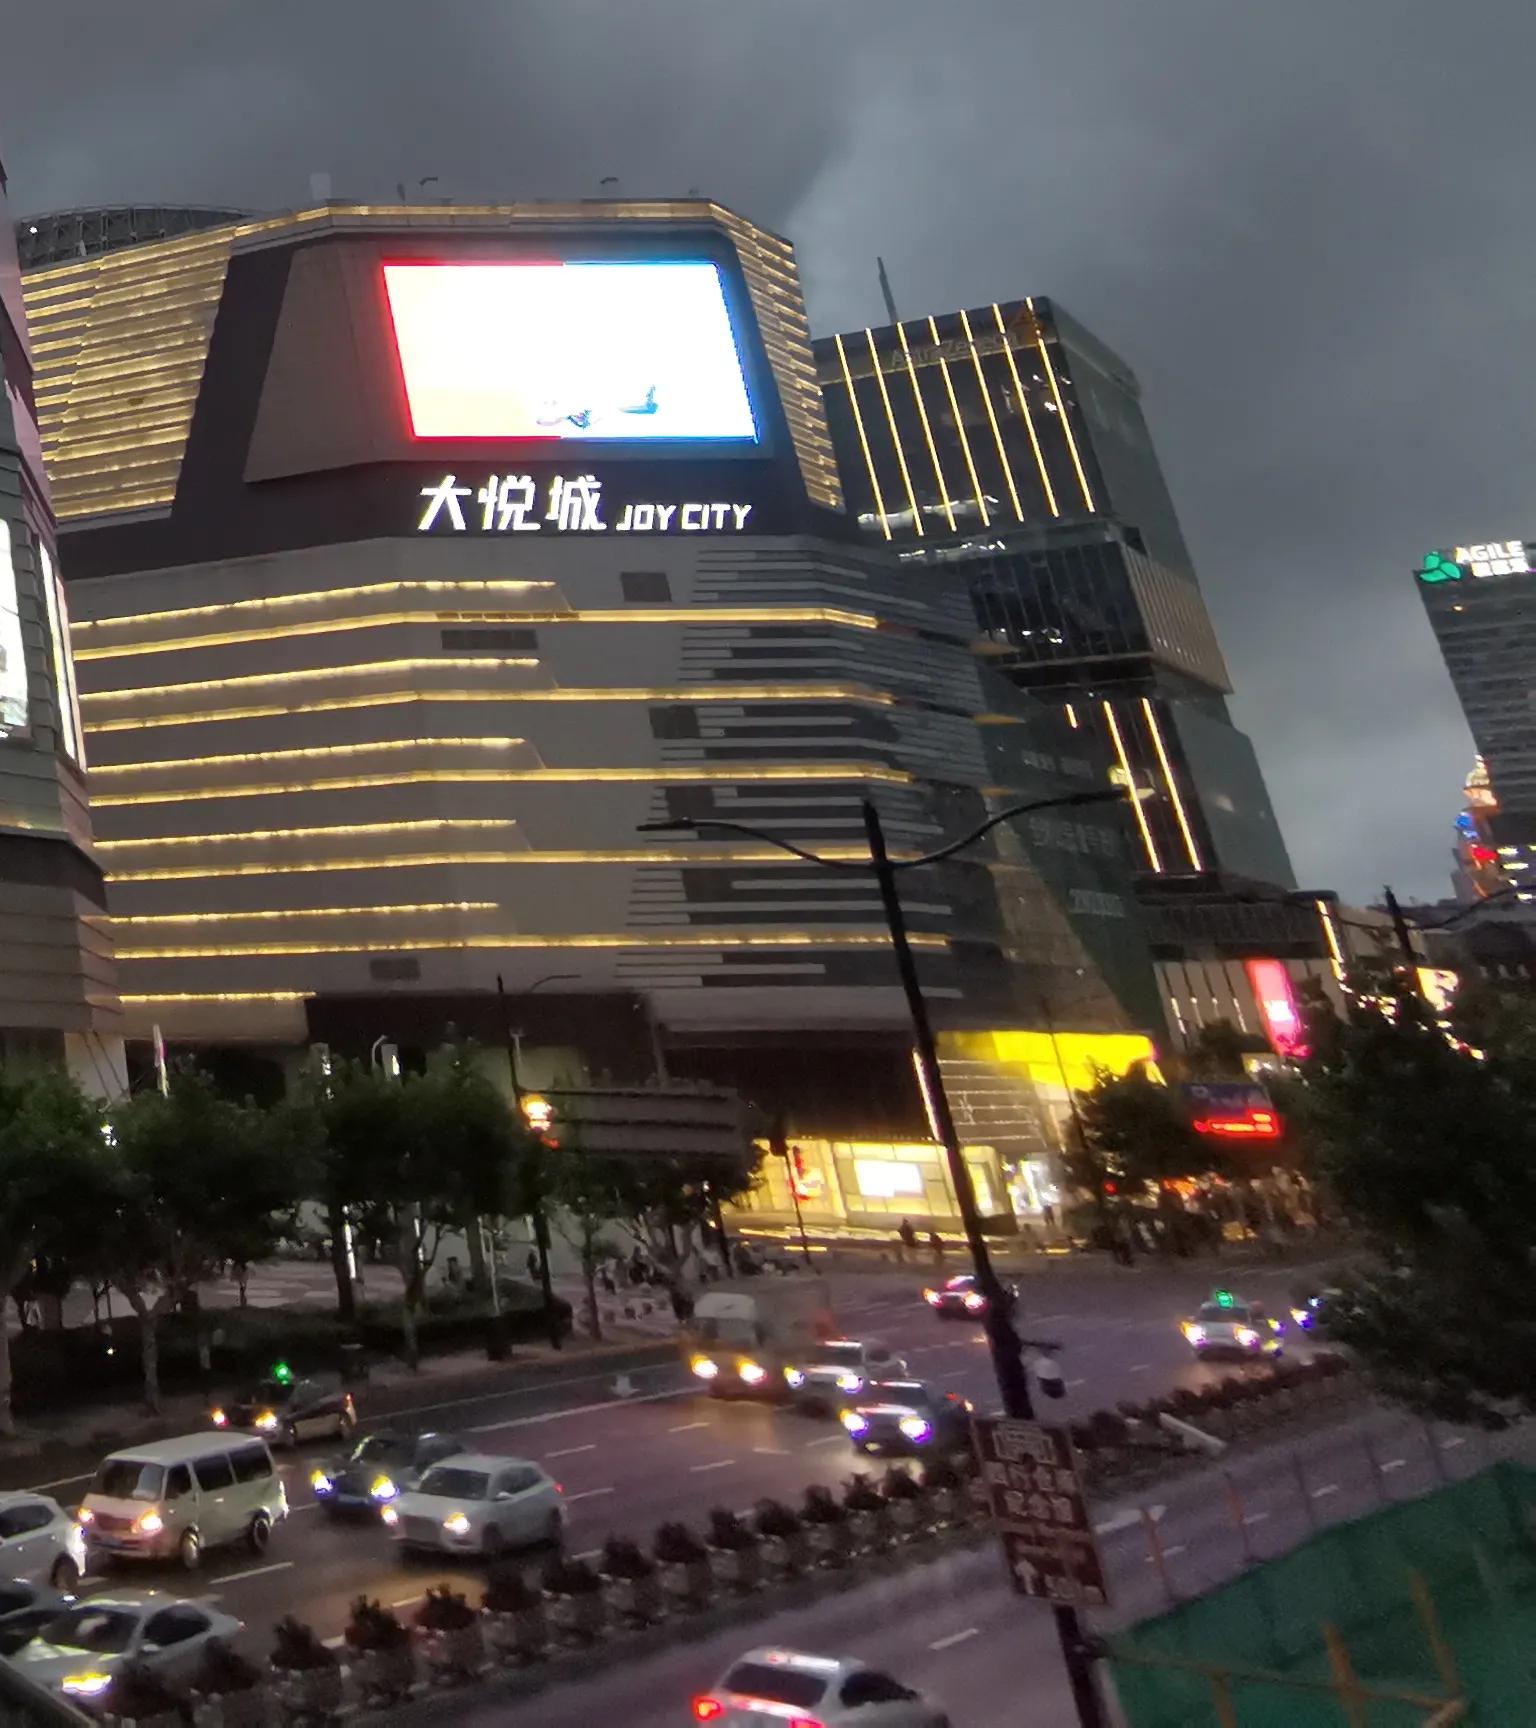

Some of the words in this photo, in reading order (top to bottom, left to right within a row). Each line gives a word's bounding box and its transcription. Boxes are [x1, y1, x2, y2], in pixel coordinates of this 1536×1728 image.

[417, 475, 607, 531] 大悦城
[616, 504, 676, 531] JOY
[681, 504, 752, 530] CITY
[1454, 540, 1525, 564] AGILE
